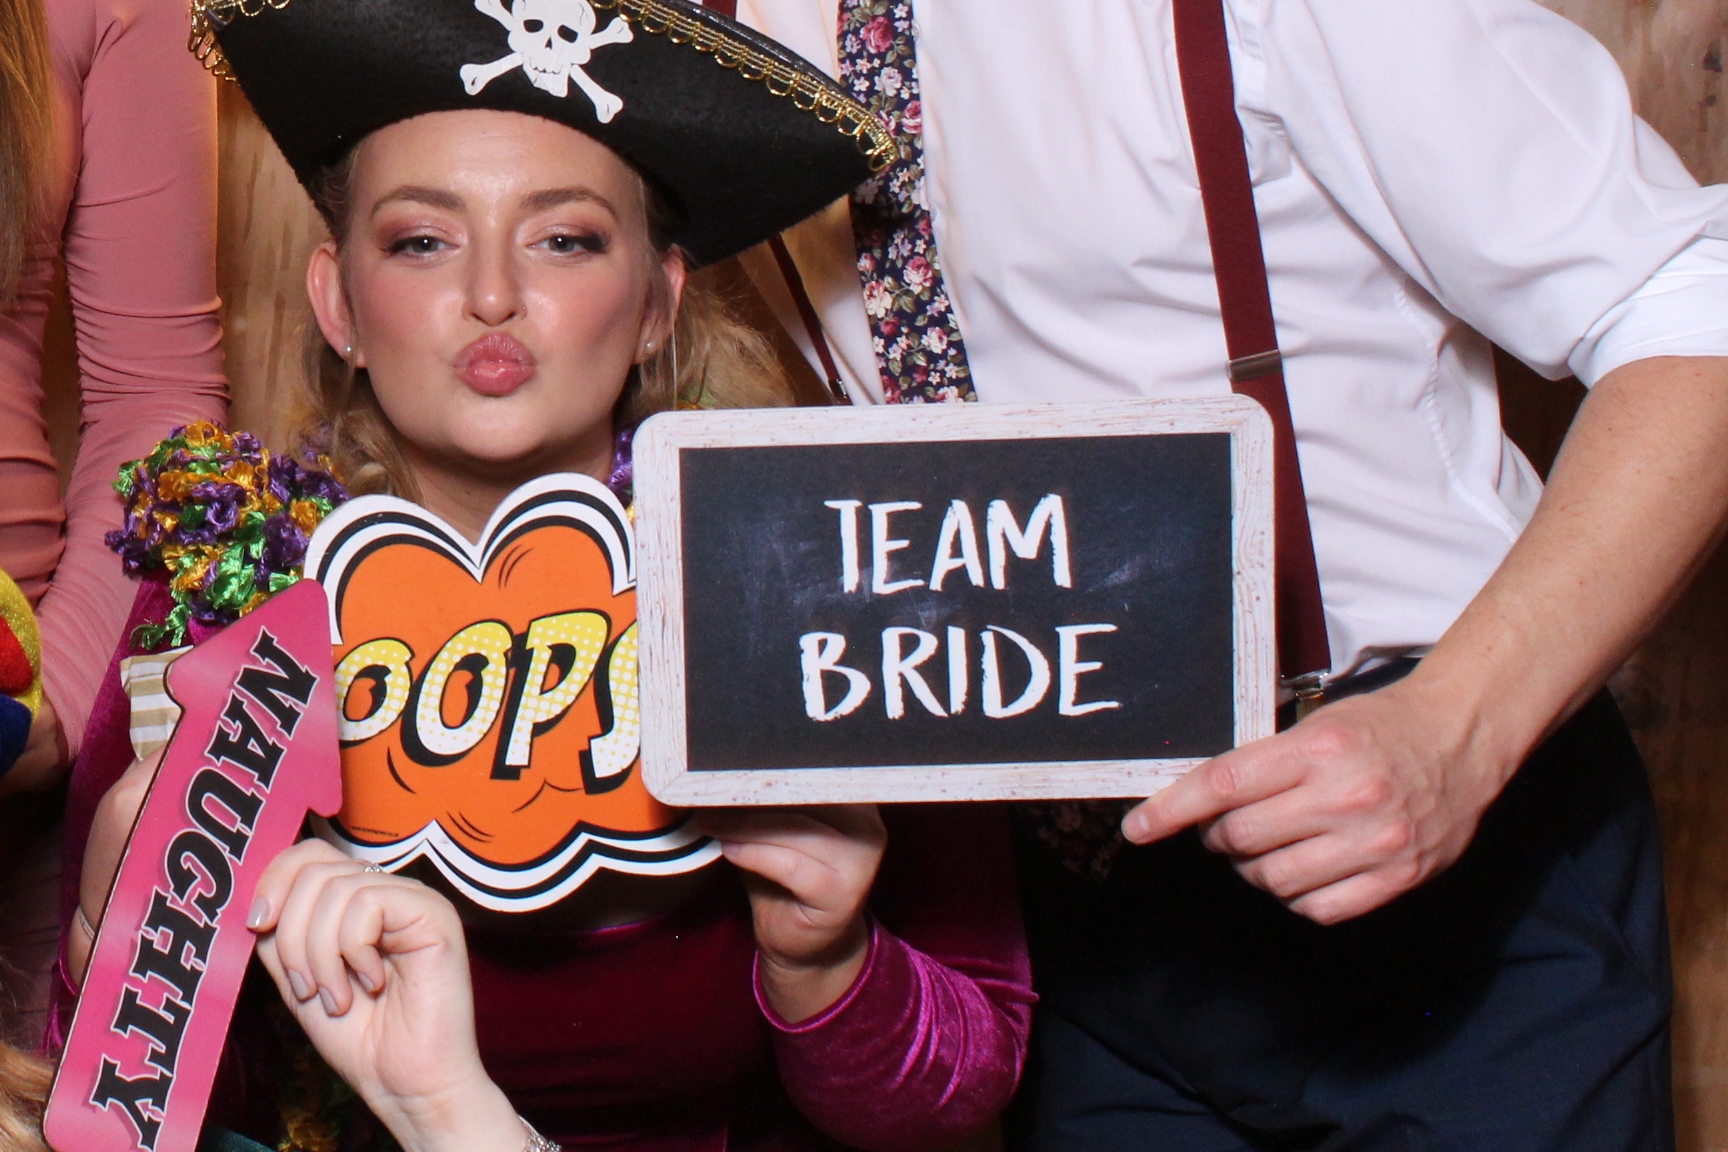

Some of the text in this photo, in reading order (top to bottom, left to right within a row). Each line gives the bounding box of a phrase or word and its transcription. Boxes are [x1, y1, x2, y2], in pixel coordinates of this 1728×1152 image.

[824, 493, 1072, 594] TEAM
[798, 623, 1122, 723] BRIDE
[89, 625, 319, 1152] NAUGHTY
